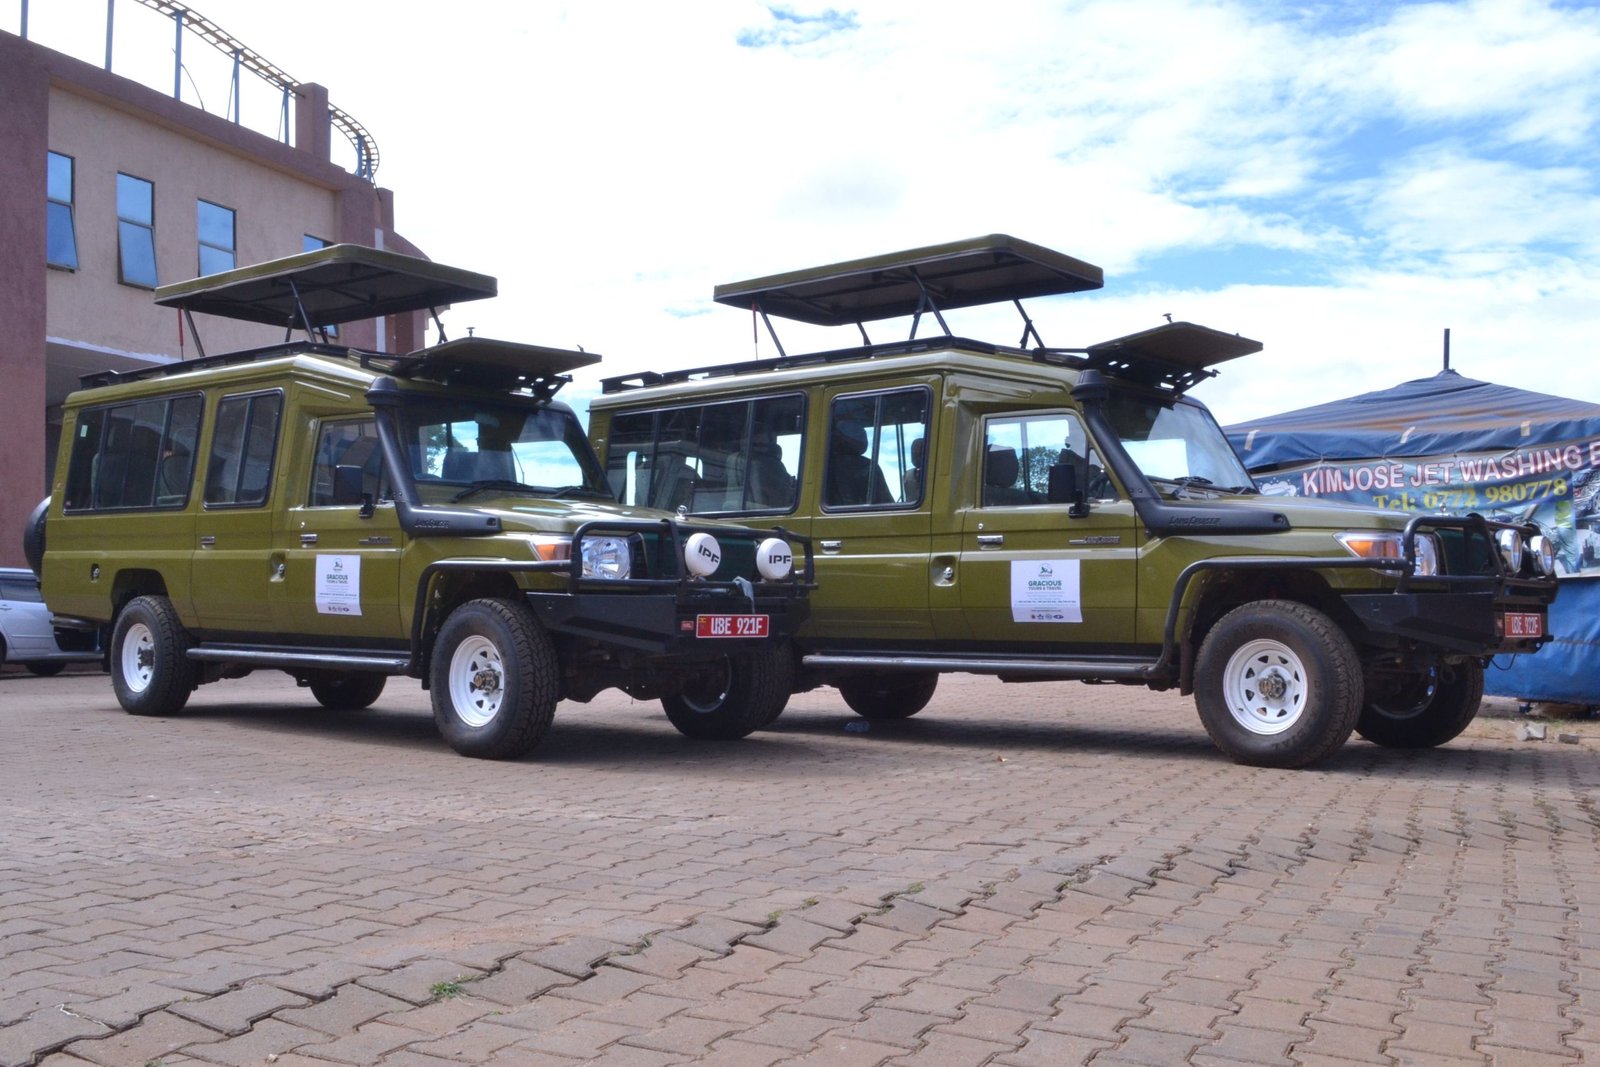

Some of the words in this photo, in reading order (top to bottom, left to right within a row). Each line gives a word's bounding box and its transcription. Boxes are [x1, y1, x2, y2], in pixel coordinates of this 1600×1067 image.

[1302, 463, 1406, 497] KIMJOSE
[1410, 461, 1455, 487] JET
[1460, 444, 1582, 482] WASHING
[1373, 491, 1417, 512] Tel:
[1484, 477, 1569, 505] 980778
[698, 544, 720, 564] IPF
[768, 554, 792, 564] IPF
[711, 617, 732, 635] UBE
[737, 617, 763, 635] 921F
